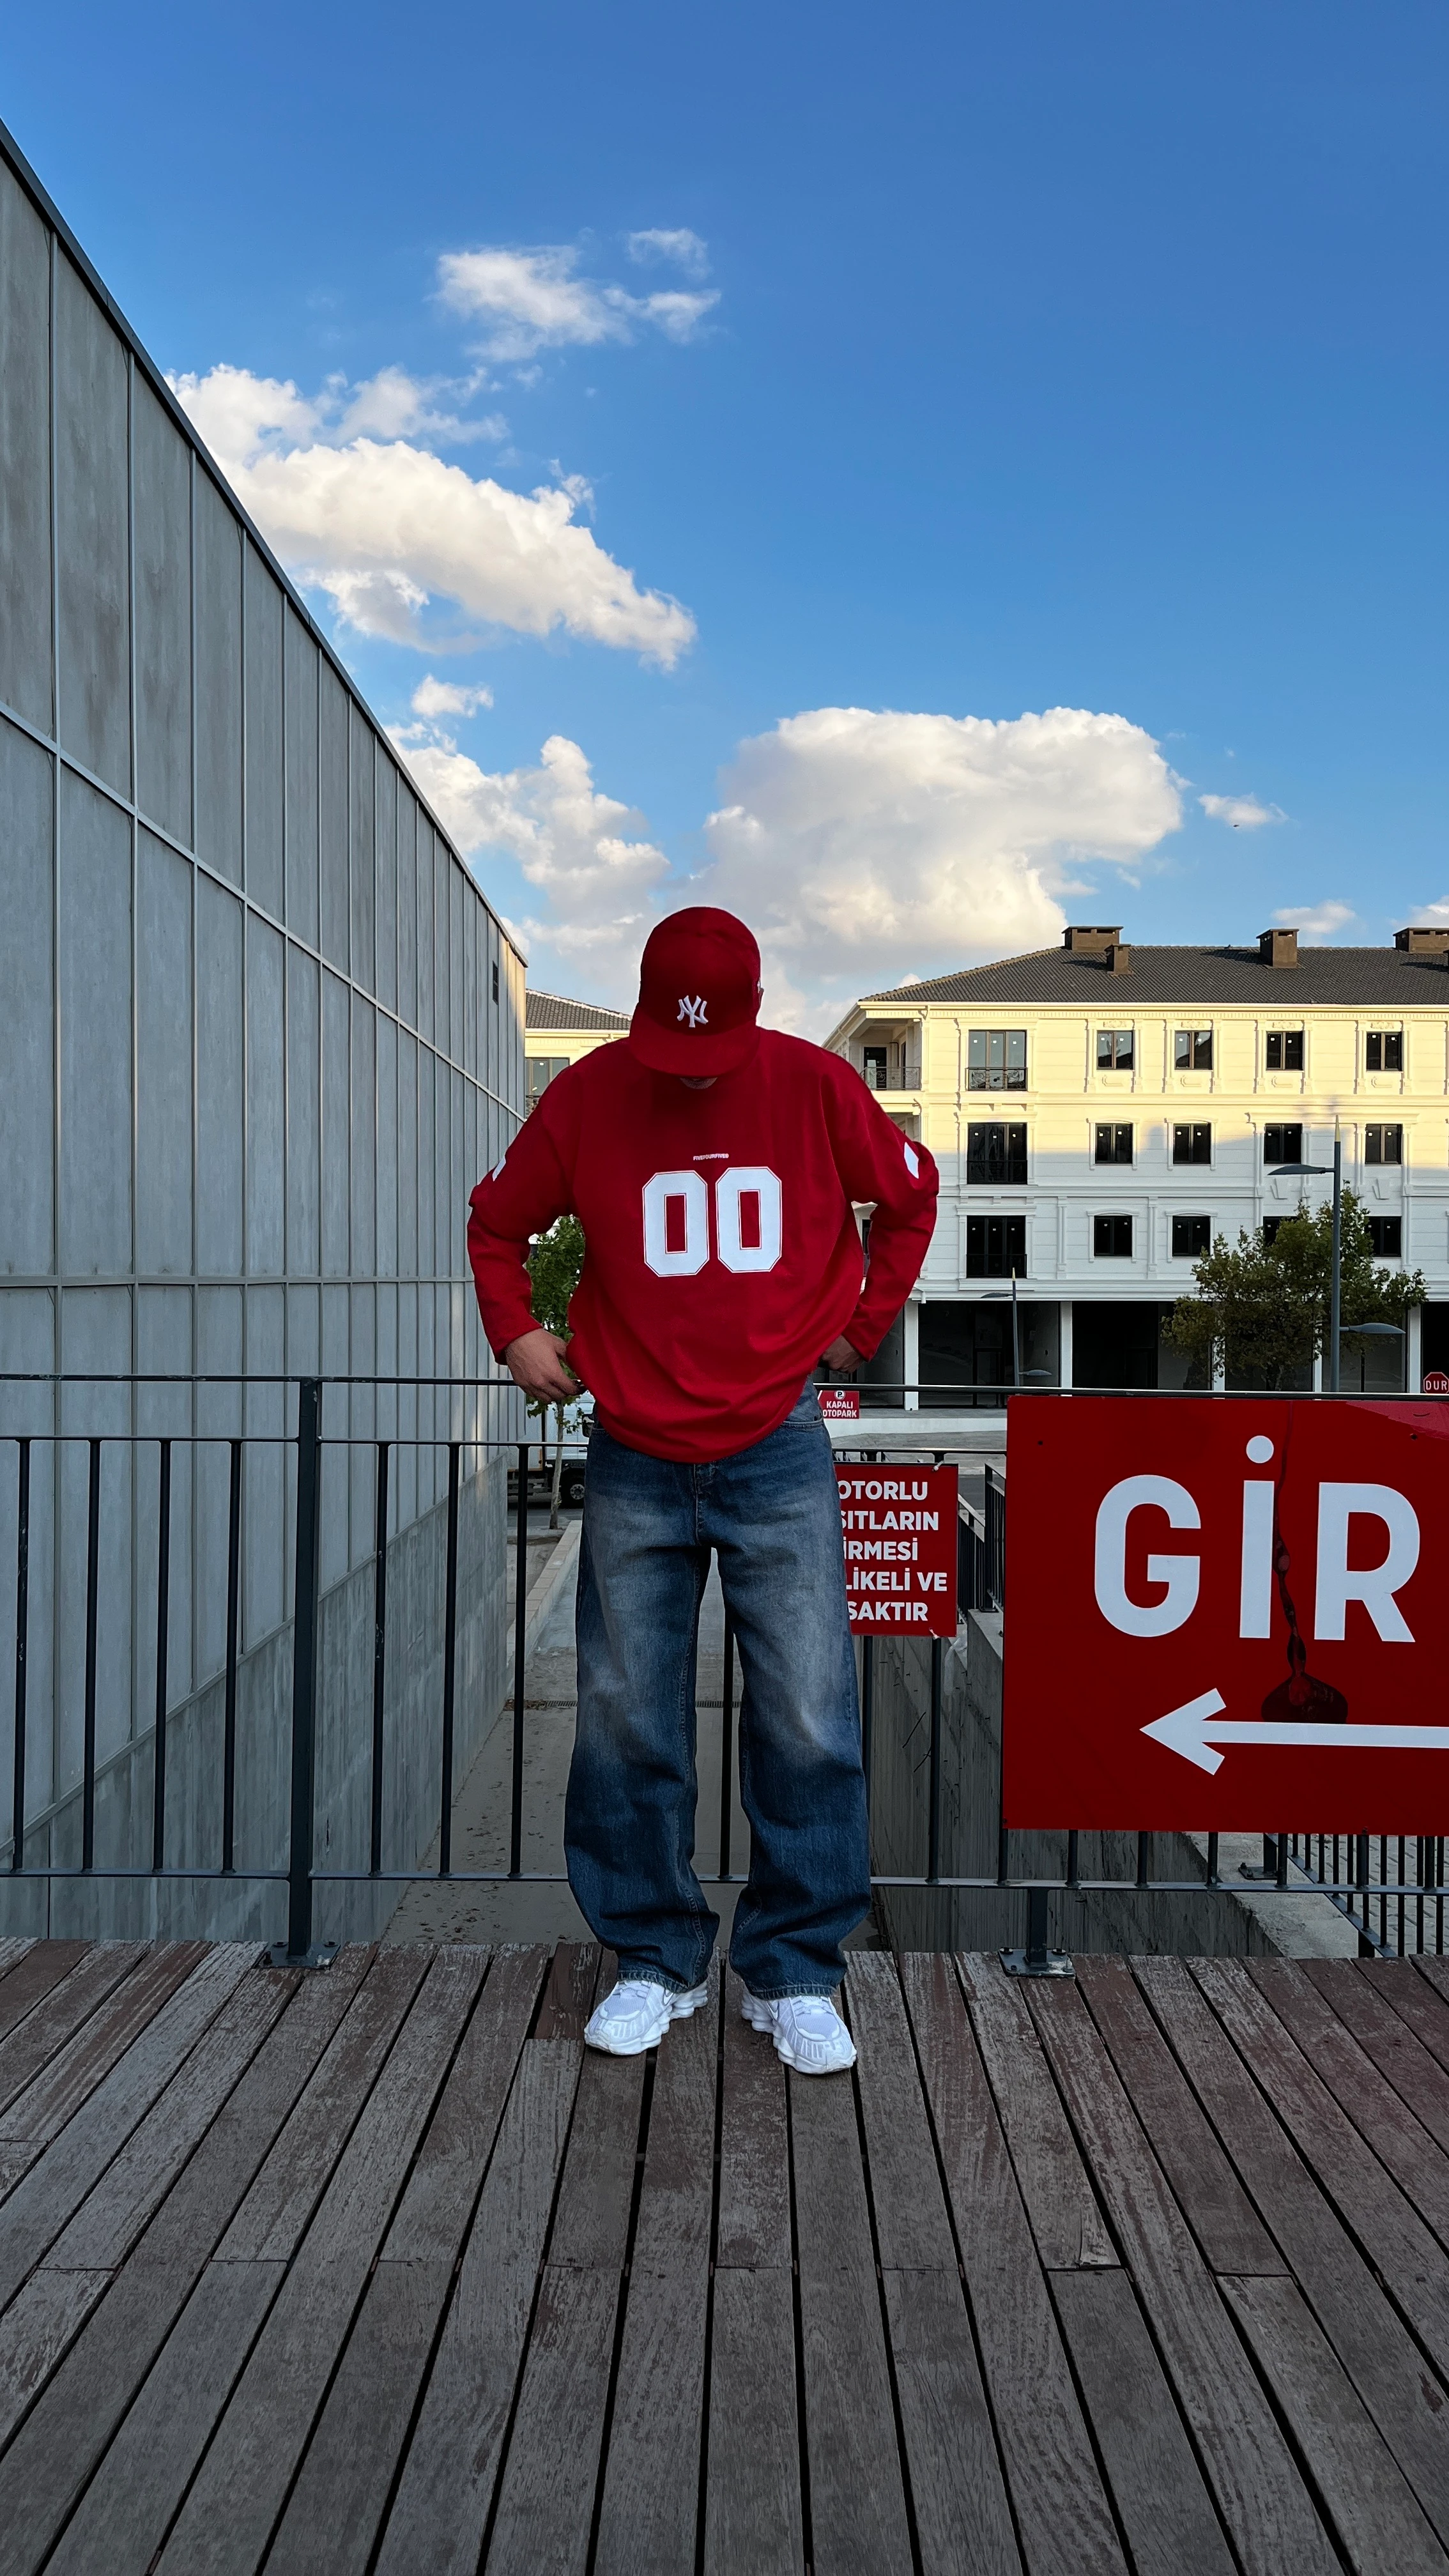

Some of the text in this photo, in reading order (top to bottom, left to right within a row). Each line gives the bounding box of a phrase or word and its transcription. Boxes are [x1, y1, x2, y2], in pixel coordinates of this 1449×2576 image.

[677, 995, 709, 1028] NY
[642, 1166, 783, 1277] 00
[1425, 1380, 1447, 1391] DUR
[822, 1409, 857, 1418] OTOPARK
[826, 1400, 854, 1409] KAPALI
[1094, 1435, 1421, 1643] GİR
[917, 1572, 947, 1591] VE
